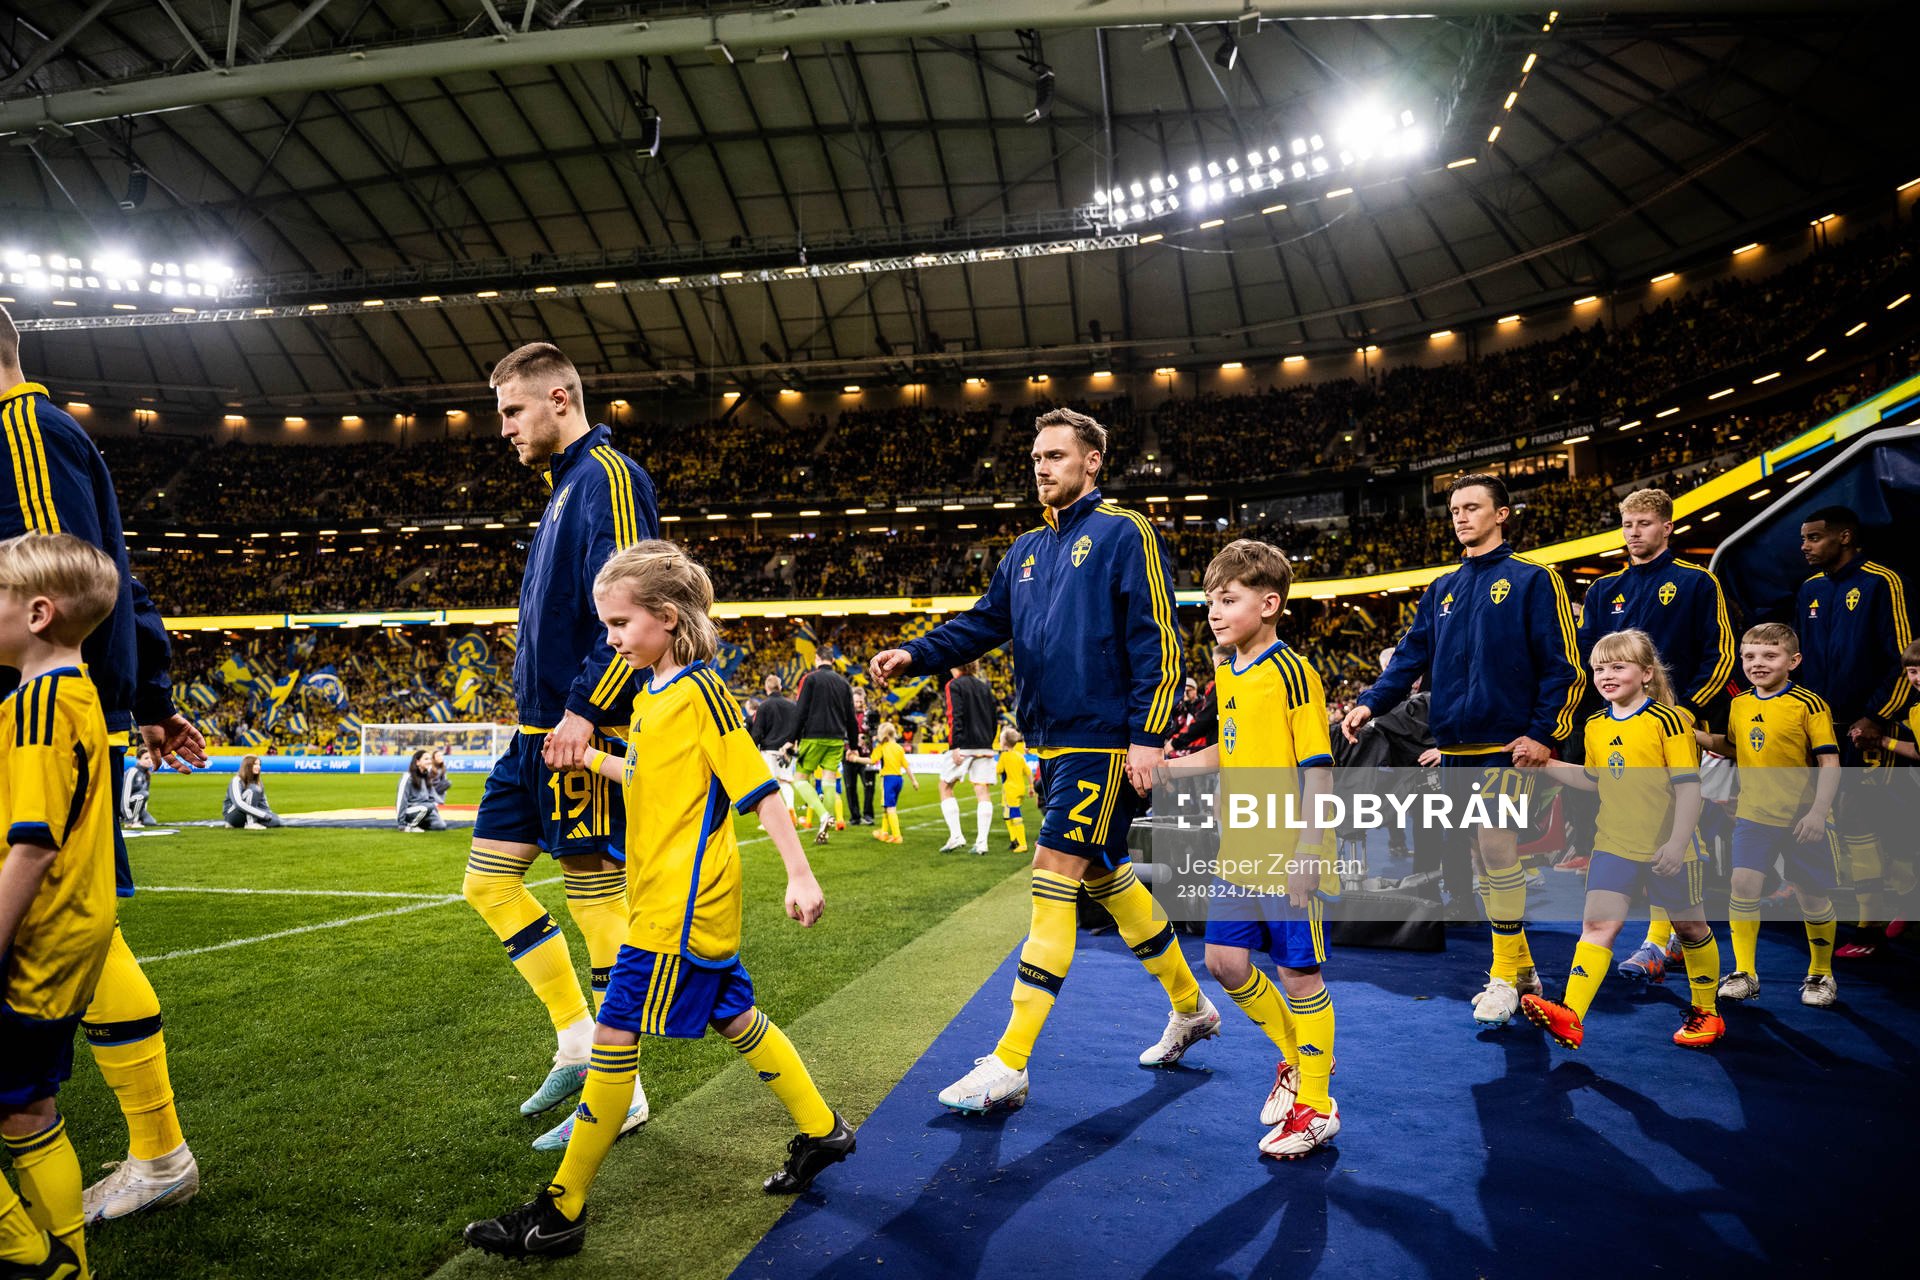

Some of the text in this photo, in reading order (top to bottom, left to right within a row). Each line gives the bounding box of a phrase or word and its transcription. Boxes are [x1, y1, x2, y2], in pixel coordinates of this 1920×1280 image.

[1409, 454, 1456, 471] TILLSAMMANS
[1457, 450, 1472, 461] MOT
[1531, 431, 1565, 445] FRIENDS
[1566, 424, 1595, 438] ARENA
[294, 759, 322, 769] PEACE
[1480, 768, 1522, 802] 20
[547, 771, 591, 820] 19
[1068, 780, 1101, 825] 2
